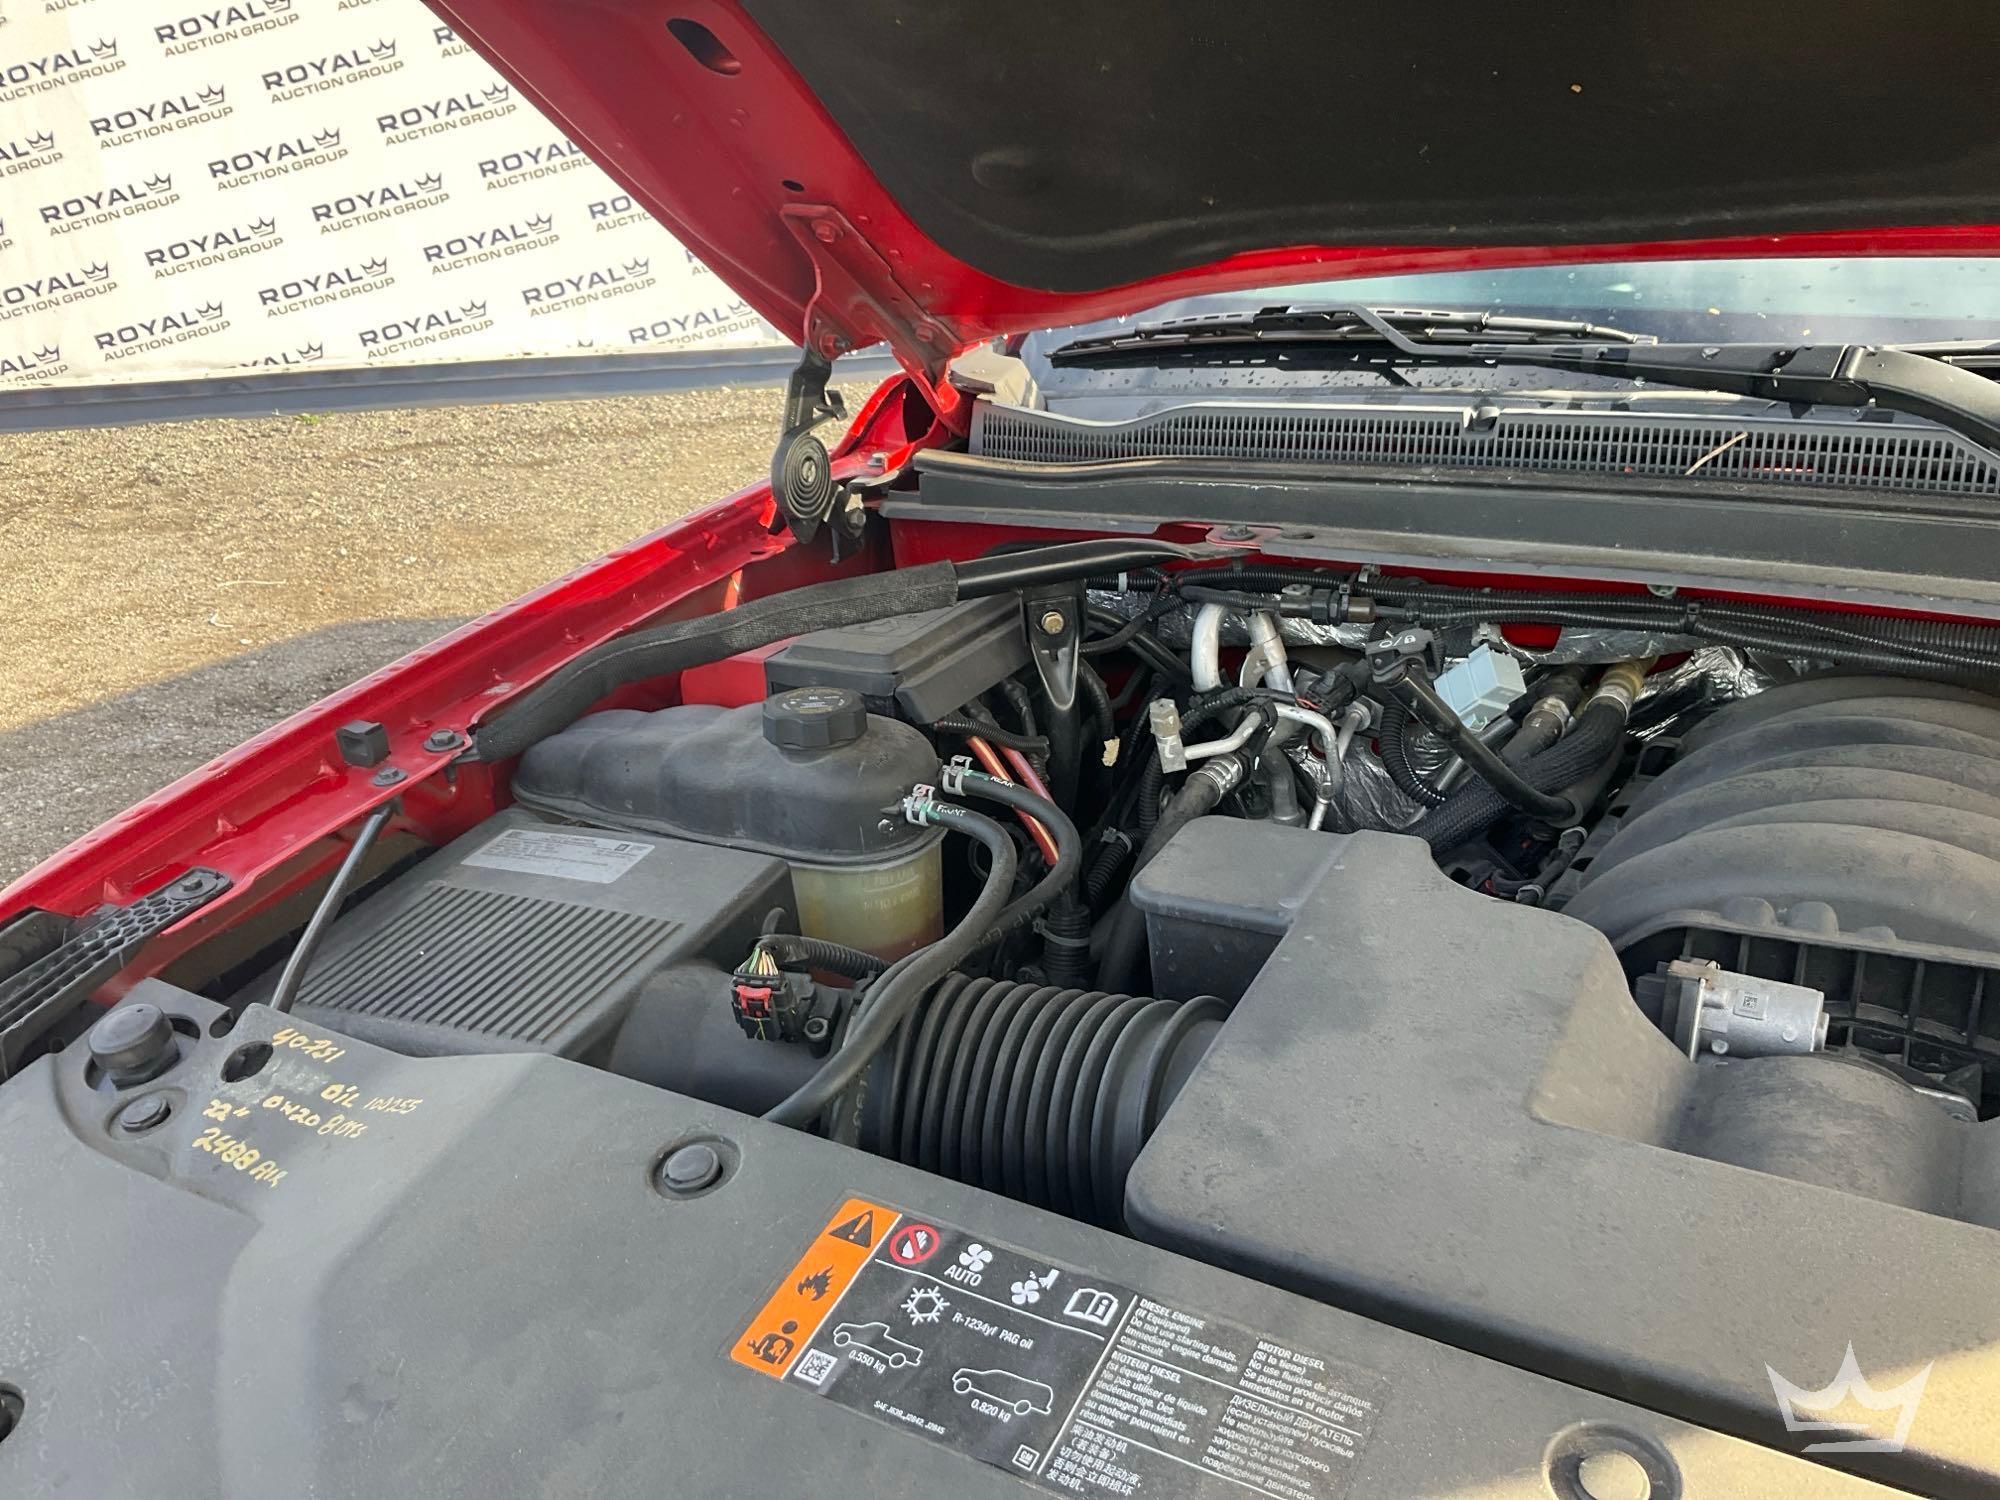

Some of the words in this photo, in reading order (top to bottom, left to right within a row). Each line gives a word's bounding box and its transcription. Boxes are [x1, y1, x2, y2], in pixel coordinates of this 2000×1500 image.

[155, 1, 266, 43] ROYAL
[165, 30, 238, 57] AUCTION
[242, 13, 299, 37] GROUP
[68, 60, 126, 83] GROUP
[261, 50, 371, 90] ROYAL
[271, 76, 343, 104] AUCTION
[346, 60, 404, 84] GROUP
[90, 95, 200, 136] ROYAL
[100, 121, 173, 150] AUCTION
[176, 105, 234, 129] GROUP
[376, 93, 484, 133] ROYAL
[385, 120, 457, 147] AUCTION
[460, 104, 516, 127] GROUP
[6, 152, 63, 175] GROUP
[208, 138, 315, 178] ROYAL
[217, 164, 289, 191] AUCTION
[292, 148, 348, 172] GROUP
[487, 165, 557, 190] AUCTION
[39, 183, 147, 224] ROYAL
[49, 209, 121, 237] AUCTION
[123, 194, 180, 216] GROUP
[311, 183, 416, 222] ROYAL
[320, 209, 391, 235] AUCTION
[394, 193, 450, 215] GROUP
[144, 228, 250, 266] ROYAL
[154, 253, 224, 279] AUCTION
[228, 237, 284, 259] GROUP
[423, 224, 528, 262] ROYAL
[431, 249, 501, 275] AUCTION
[504, 234, 560, 256] GROUP
[0, 272, 85, 307] OYAL
[0, 298, 60, 321] UCTION
[62, 282, 118, 304] GROUP
[258, 267, 363, 306] ROYAL
[267, 293, 337, 318] AUCTION
[339, 277, 396, 299] GROUP
[522, 267, 624, 304] ROYAL
[530, 293, 598, 317] AUCTION
[601, 277, 656, 299] GROUP
[94, 312, 199, 350] ROYAL
[104, 336, 174, 362] AUCTION
[176, 321, 231, 343] GROUP
[359, 309, 462, 346] ROYAL
[367, 331, 436, 359] AUCTION
[438, 320, 494, 341] GROUP
[629, 308, 729, 344] ROYAL
[706, 317, 761, 338] GROUP
[944, 1265, 982, 1286] AUTO
[952, 1313, 998, 1336] R-1234yf
[999, 1329, 1021, 1345] PAG
[1020, 1337, 1034, 1349] oil
[1139, 1299, 1171, 1315] DIESEL
[1171, 1311, 1205, 1328] ENGINE
[1145, 1312, 1190, 1335] Equipped)
[1120, 1335, 1137, 1346] can
[1125, 1326, 1171, 1348] Immediate
[1170, 1343, 1201, 1360] engine
[1200, 1354, 1238, 1373] damage
[1130, 1316, 1143, 1326] Do
[1143, 1322, 1159, 1332] not
[1159, 1328, 1175, 1338] use
[1175, 1334, 1210, 1352] starting
[1210, 1346, 1238, 1361] fluids.
[1257, 1341, 1292, 1358] MOTOR
[1292, 1352, 1327, 1370] DIESEL
[848, 1350, 874, 1367] 0.550
[872, 1359, 886, 1374] kg
[1111, 1351, 1149, 1370] MOTEUR
[1149, 1365, 1183, 1382] DIESEL
[1248, 1360, 1262, 1369] No
[1263, 1365, 1280, 1375] use
[1281, 1370, 1313, 1387] fluidos
[1313, 1381, 1327, 1392] de
[1252, 1350, 1267, 1361] (Si
[1278, 1359, 1306, 1374] tiene)
[874, 1400, 888, 1411] SAE
[971, 1399, 998, 1416] 0.820
[997, 1409, 1012, 1423] kg
[1089, 1389, 1139, 1413] dommages
[1139, 1407, 1187, 1430] immédiats
[1100, 1370, 1114, 1379] Ne
[1113, 1376, 1131, 1388] pas
[1131, 1381, 1163, 1398] utiliser
[1163, 1393, 1176, 1403] de
[1176, 1398, 1208, 1416] liquide
[1156, 1402, 1175, 1414] Des
[1239, 1377, 1290, 1401] inmediatos
[1291, 1397, 1303, 1405] en
[1305, 1401, 1315, 1409] el
[1315, 1405, 1346, 1421] motor.
[1243, 1369, 1257, 1378] Se
[1257, 1373, 1292, 1392] pueden
[1293, 1385, 1332, 1406] producir
[1334, 1401, 1363, 1416] daños
[1079, 1408, 1116, 1427] résulter.
[1084, 1399, 1097, 1408] au
[1097, 1404, 1130, 1421] moteur
[1129, 1416, 1177, 1439] pourraient
[1221, 1415, 1236, 1425] Не
[1230, 1394, 1294, 1423] ДИЗЕЛЬНЫЙ
[1294, 1417, 1355, 1445] ДВИГАТЕЛЬ
